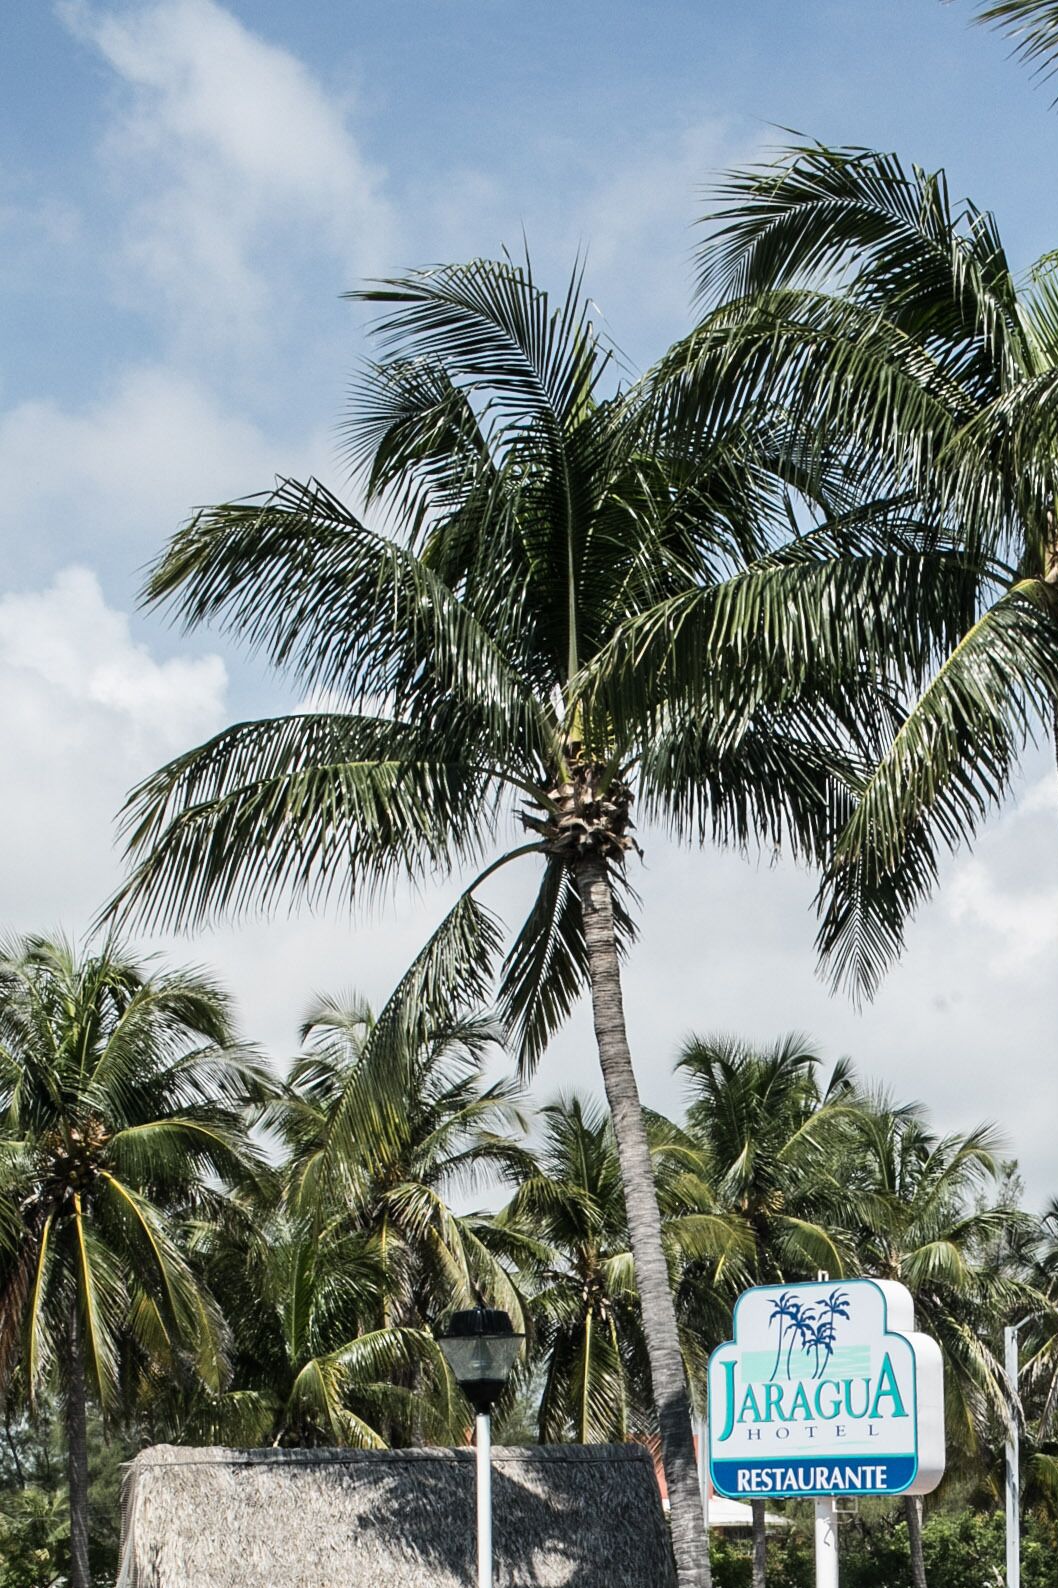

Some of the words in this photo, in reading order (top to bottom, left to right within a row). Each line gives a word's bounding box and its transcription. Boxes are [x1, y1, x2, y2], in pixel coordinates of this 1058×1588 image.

[717, 1352, 909, 1442] JARAGUA
[748, 1424, 879, 1441] HOTEL
[737, 1466, 887, 1491] RESTAURANTE
